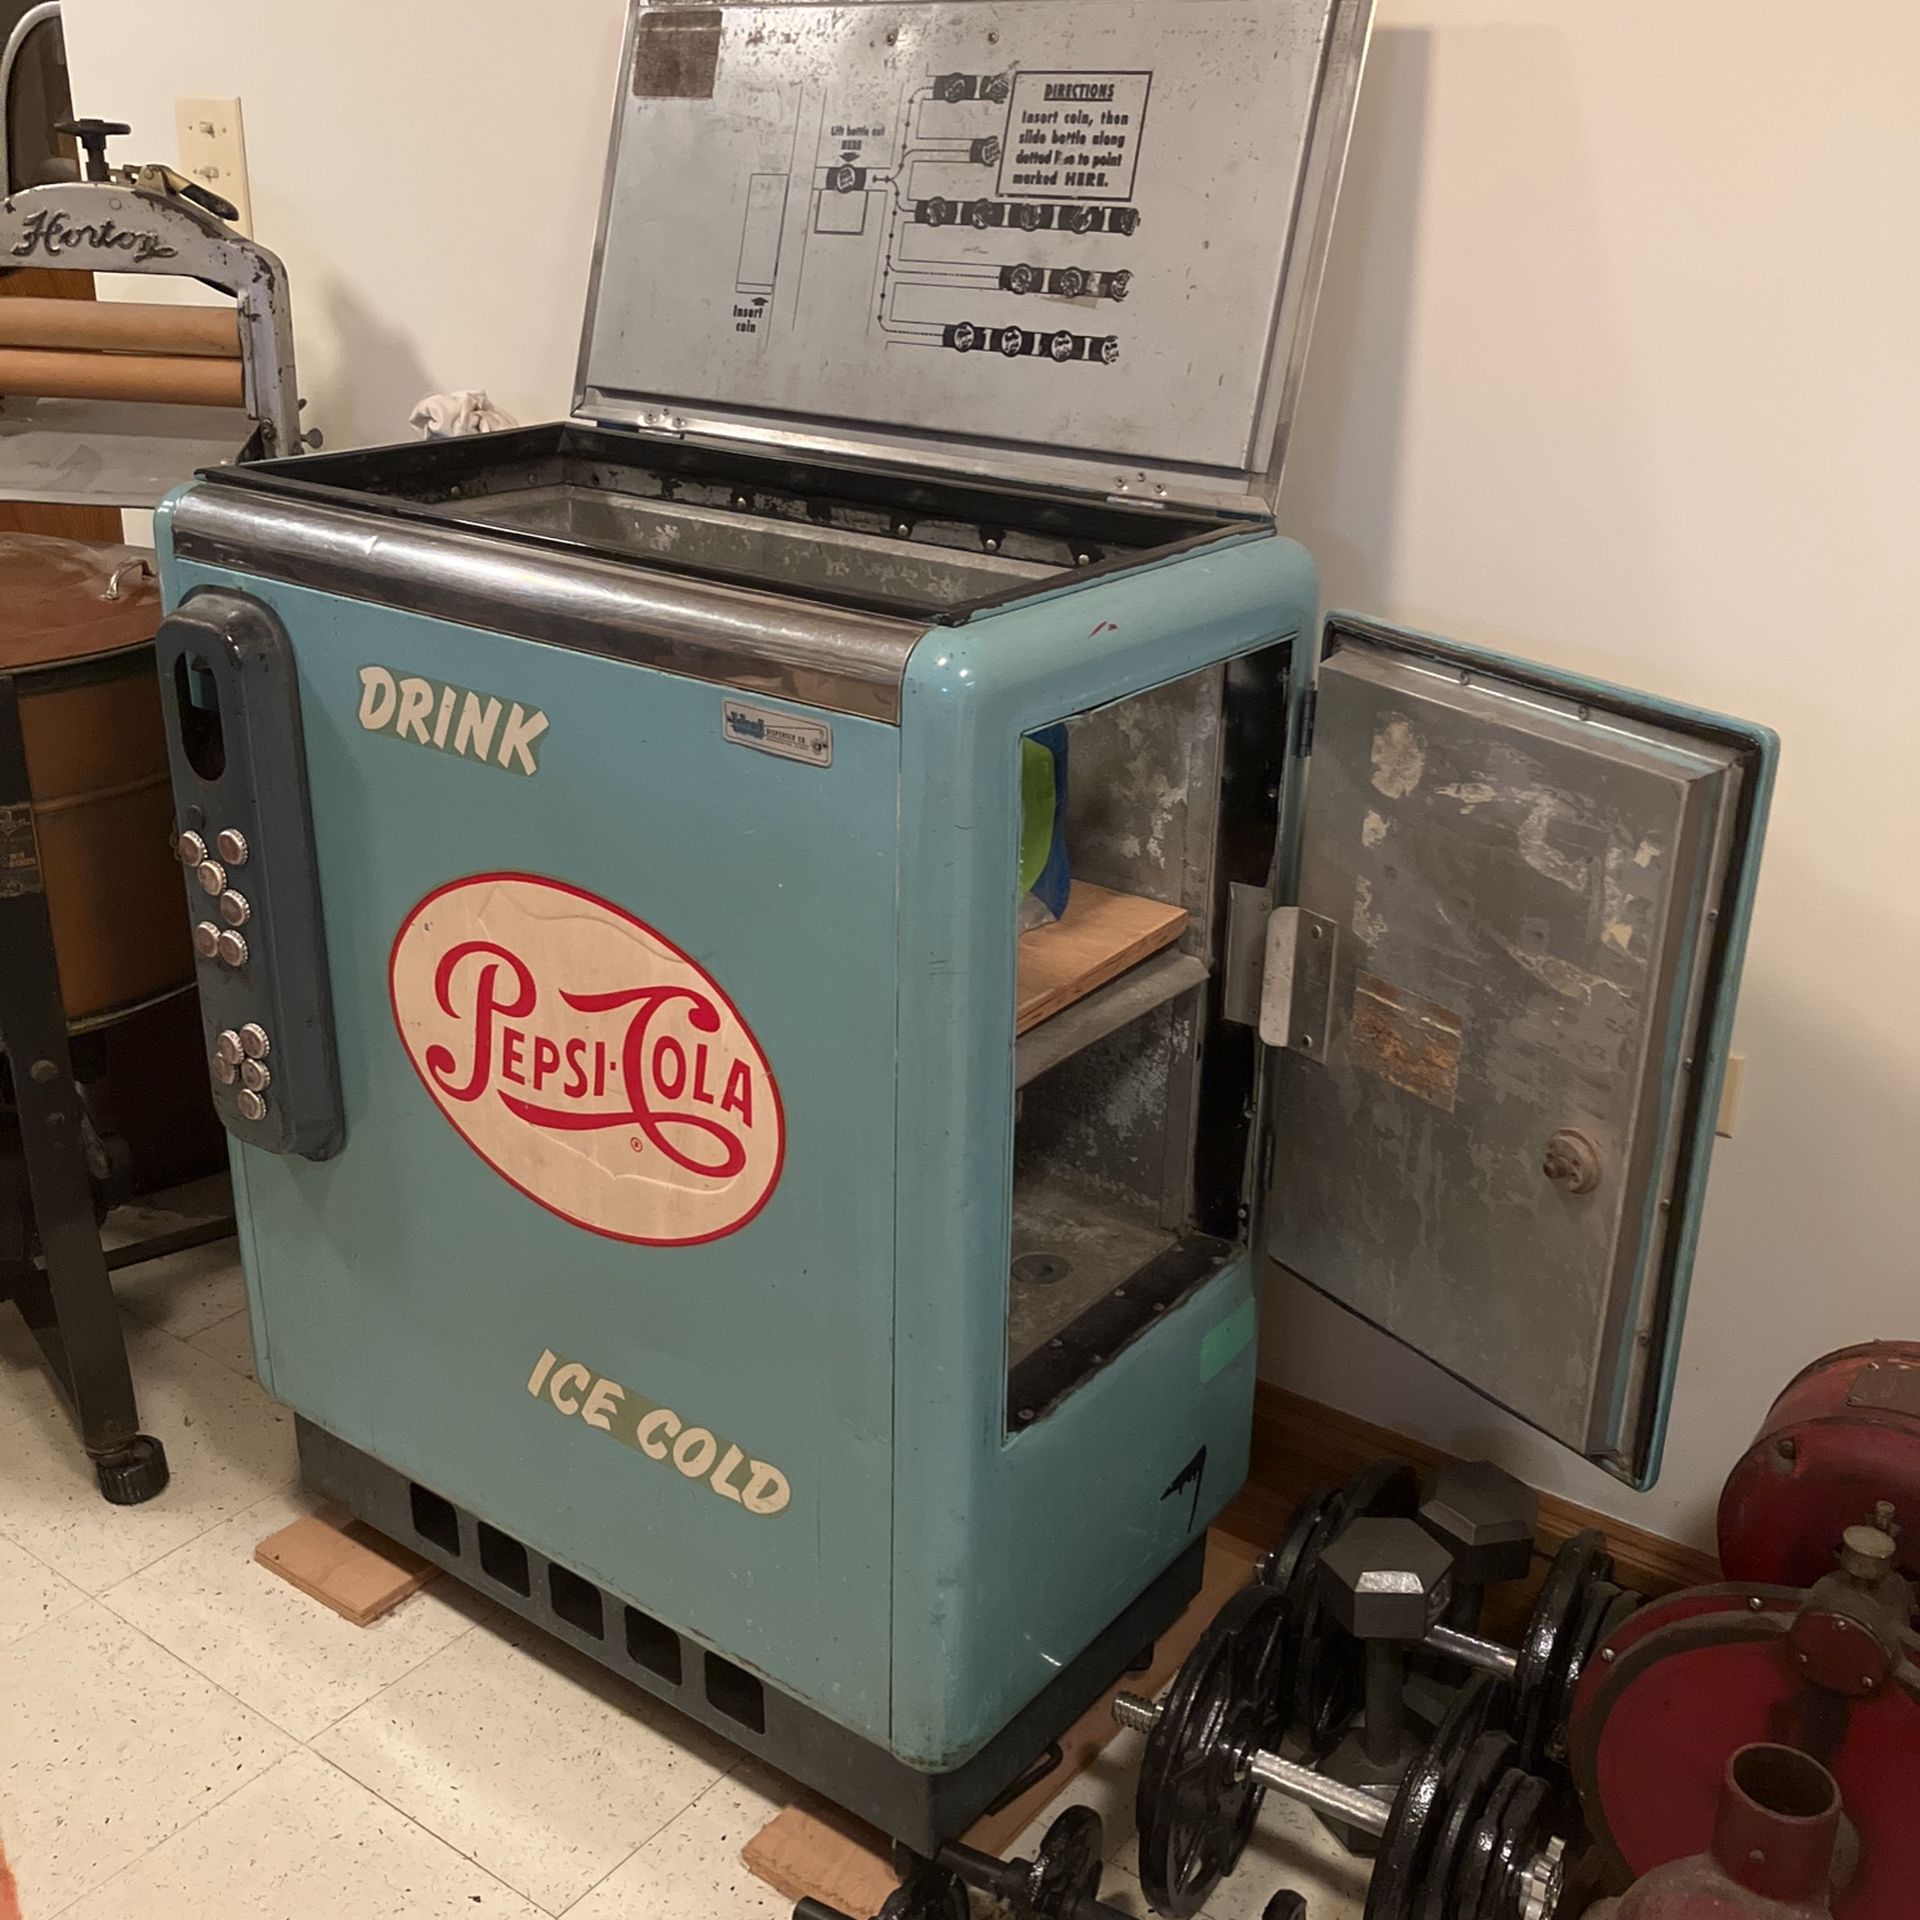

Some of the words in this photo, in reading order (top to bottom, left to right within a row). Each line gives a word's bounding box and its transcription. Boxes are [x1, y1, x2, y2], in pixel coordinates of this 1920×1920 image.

[1044, 83, 1115, 99] DIRECTIONS
[1022, 110, 1058, 125] Insert
[1064, 110, 1093, 126] coin,
[1100, 111, 1129, 125] then
[1018, 130, 1047, 145] slide
[1051, 130, 1087, 146] bottle
[1092, 131, 1125, 148] along
[1016, 150, 1052, 165] dotted
[1077, 153, 1089, 166] to
[1091, 151, 1123, 169] point
[1012, 170, 1058, 186] marked
[1064, 172, 1109, 188] HERE.
[11, 208, 179, 264] Horton
[733, 304, 764, 319] Insert
[736, 319, 756, 333] coin
[359, 666, 550, 776] DRINK
[527, 1348, 626, 1432] ICE
[636, 1408, 791, 1514] COLD
